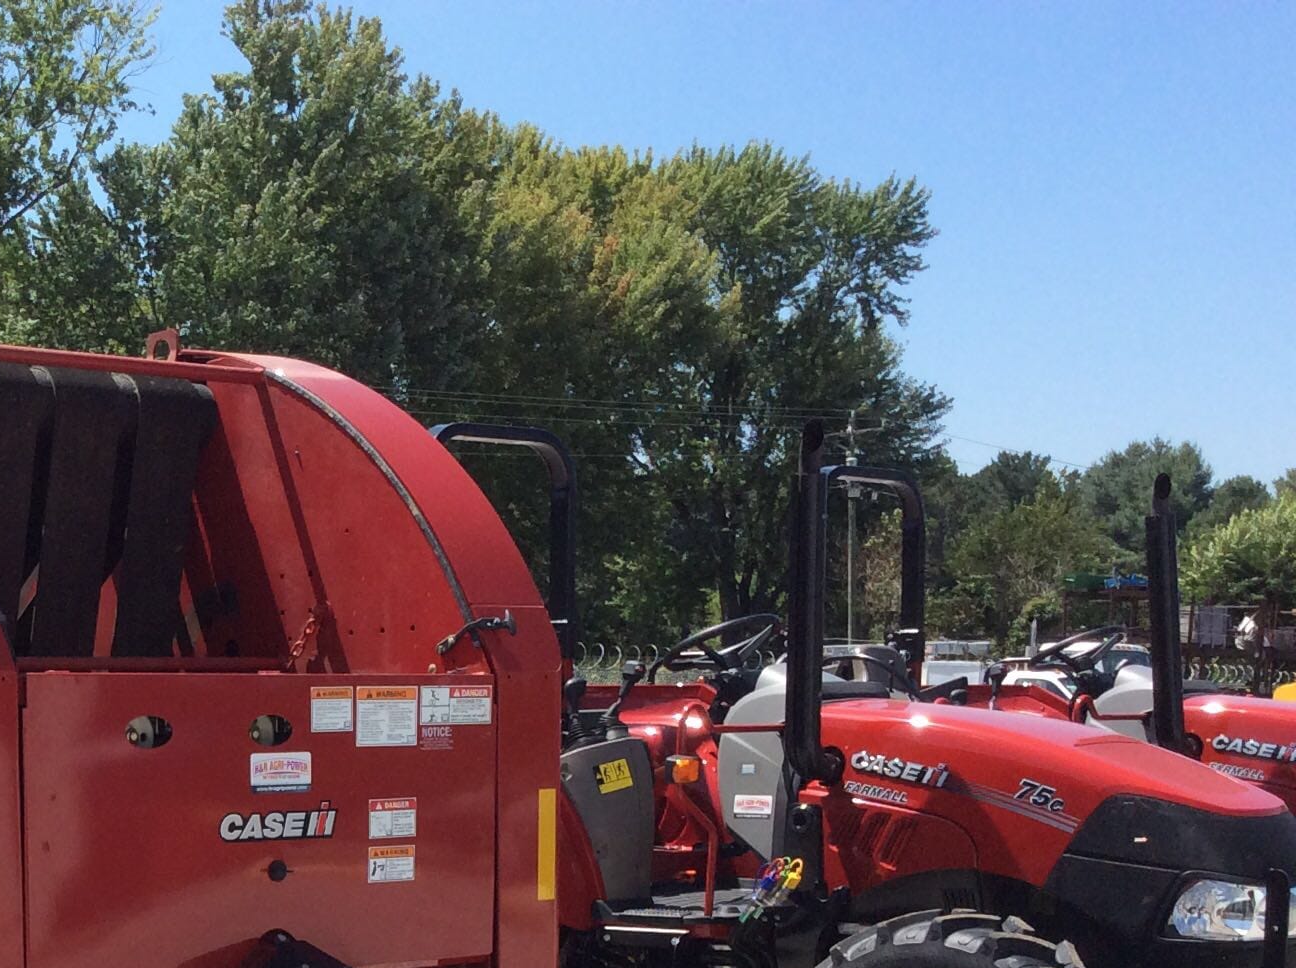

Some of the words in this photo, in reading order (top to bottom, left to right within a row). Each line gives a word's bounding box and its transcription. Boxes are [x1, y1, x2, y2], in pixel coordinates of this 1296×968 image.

[375, 690, 407, 698] WARNING
[461, 688, 488, 697] DANGER
[421, 726, 453, 738] NOTICE:
[1211, 733, 1277, 758] CASE
[851, 750, 923, 782] CASE
[843, 781, 908, 804] FARMALL
[384, 800, 410, 809] DANGER
[219, 812, 306, 842] CASE
